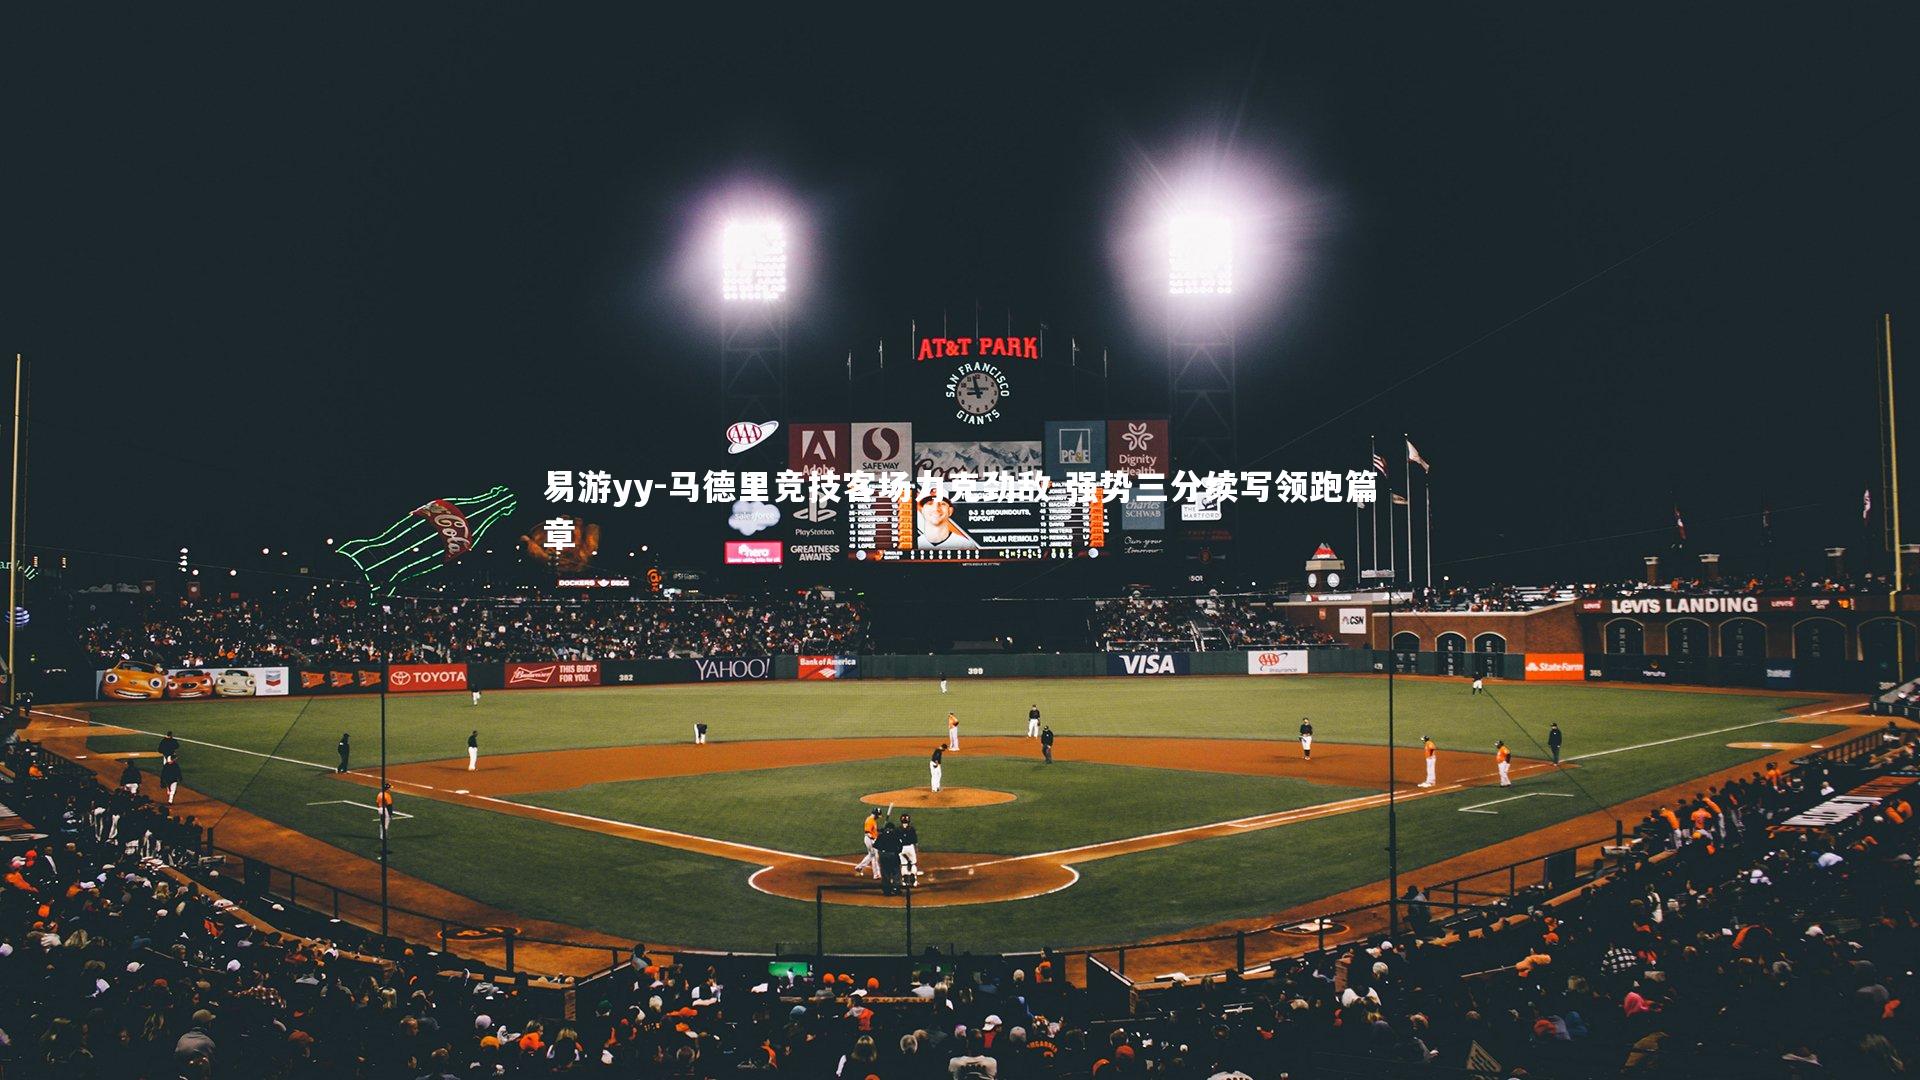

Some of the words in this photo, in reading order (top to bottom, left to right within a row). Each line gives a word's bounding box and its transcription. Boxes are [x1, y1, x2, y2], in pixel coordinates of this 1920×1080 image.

[918, 337, 972, 361] AT&T
[979, 337, 1039, 360] PARK
[945, 373, 960, 398] SAN
[958, 361, 1010, 397] FRANCISCO
[956, 409, 1000, 425] GIANTS
[1119, 454, 1157, 467] Dignity
[862, 462, 900, 470] SAFEWAY
[1125, 510, 1161, 518] SCHWAB
[434, 514, 470, 554] Cola
[795, 529, 835, 537] PlayStation
[983, 535, 1007, 543] NOLAN
[790, 545, 840, 553] GREATNESS
[799, 553, 832, 561] AWAITS
[1665, 597, 1758, 613] LANDING
[1350, 616, 1364, 625] CSN
[800, 658, 818, 666] Bank
[818, 658, 826, 666] of
[827, 658, 856, 667] America
[1118, 654, 1176, 674] VISA
[559, 665, 575, 674] THIS
[576, 664, 598, 673] BUD'S
[695, 658, 770, 681] YAHOO!
[413, 670, 467, 684] TOYOTA
[559, 674, 573, 682] FOR
